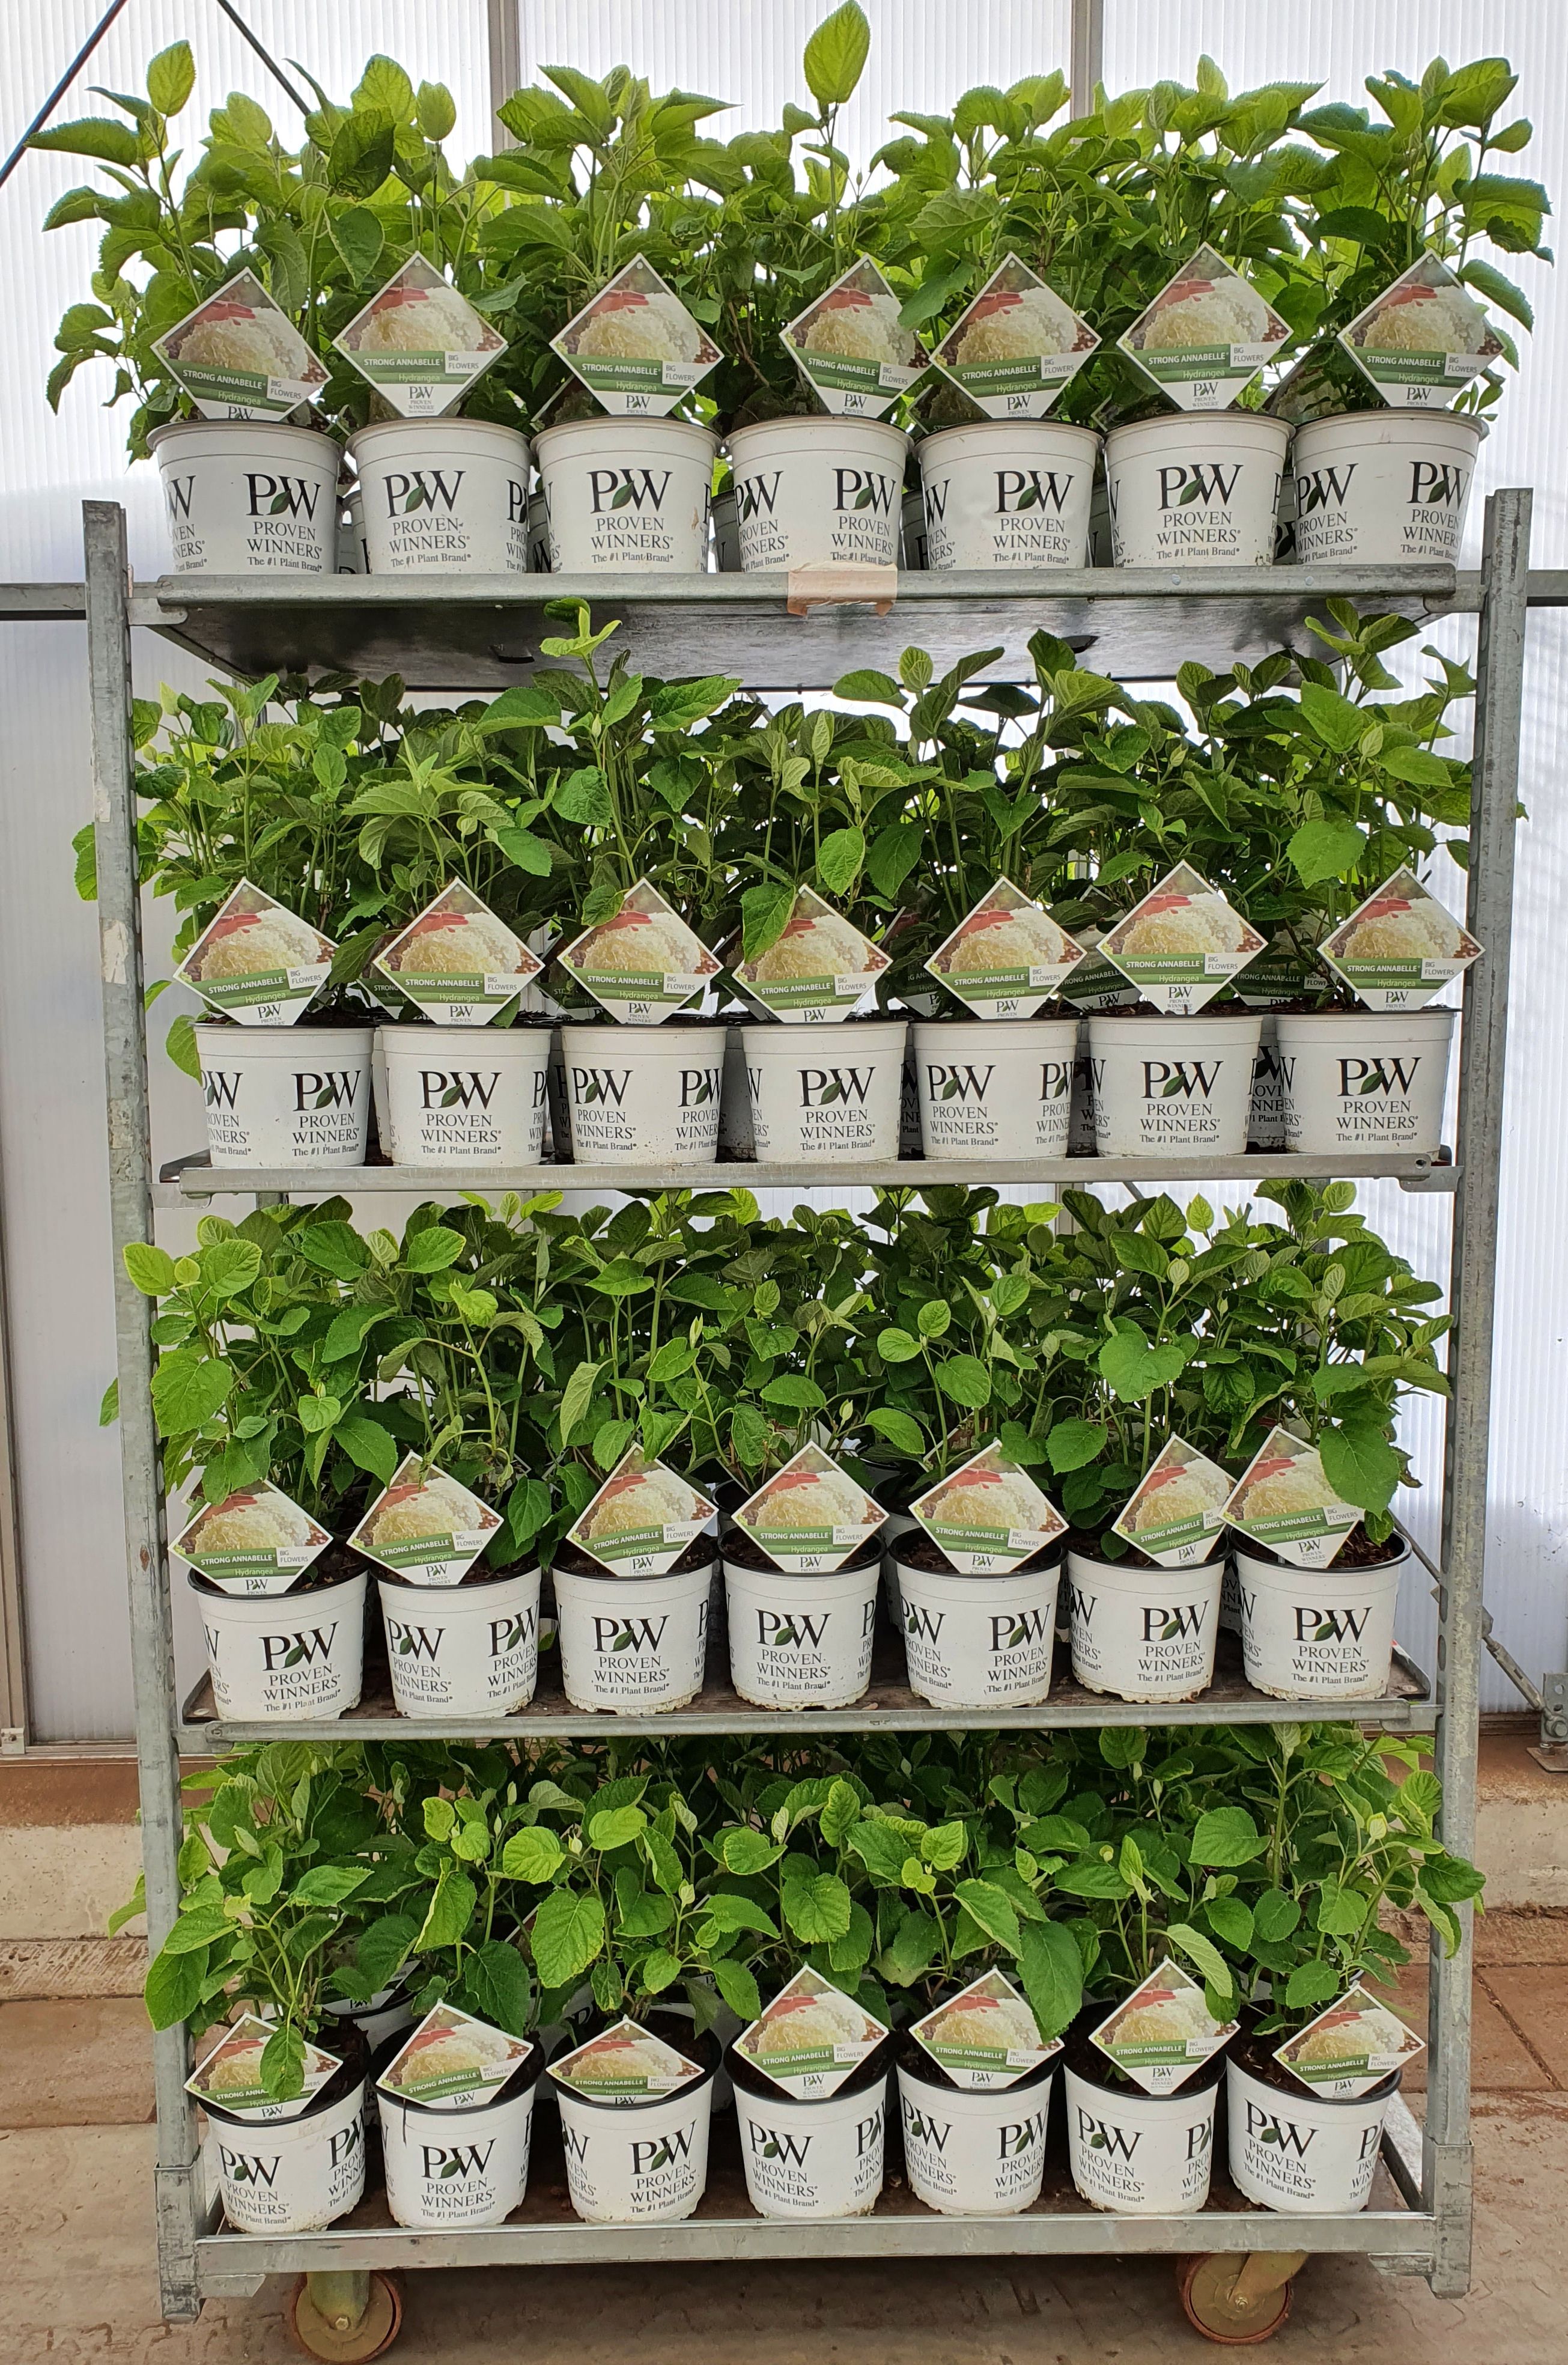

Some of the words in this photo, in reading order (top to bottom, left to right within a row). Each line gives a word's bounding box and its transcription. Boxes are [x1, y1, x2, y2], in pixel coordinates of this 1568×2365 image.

[582, 364, 613, 372] STRONG
[1149, 356, 1179, 365] STRONG
[1183, 370, 1225, 380] Hydrangea
[616, 382, 657, 392] Hydrangea
[243, 473, 321, 522] PW
[383, 470, 466, 519] PW
[586, 469, 673, 514] PW
[831, 469, 896, 517] PW
[994, 471, 1075, 514] PW
[1156, 464, 1244, 511] PW
[393, 518, 459, 536] PROVEN
[597, 516, 664, 531] PROVEN
[838, 516, 891, 537] PROVEN
[1000, 518, 1065, 532] PROVEN
[1163, 512, 1232, 528] PROVEN
[253, 522, 316, 541] PROVEN
[592, 555, 607, 563] The
[1156, 550, 1171, 559] The
[571, 1068, 633, 1107] PW
[797, 1067, 876, 1107] PW
[926, 1065, 996, 1102] PW
[1140, 1061, 1224, 1100] PW
[1336, 1057, 1422, 1096] PW
[291, 1070, 361, 1112] PW
[418, 1071, 502, 1110] PW
[577, 1110, 626, 1124] PROVEN
[806, 1109, 868, 1124] PROVEN
[932, 1106, 988, 1118] PROVEN
[1147, 1103, 1212, 1116] PROVEN
[1343, 1100, 1411, 1113] PROVEN
[299, 1113, 355, 1128] PROVEN
[427, 1114, 492, 1127] PROVEN
[1251, 1521, 1280, 1532] STRONG
[1329, 1512, 1358, 1521] FLOWERS
[1286, 1529, 1324, 1540] Hydrangea
[755, 1609, 831, 1649] PW
[988, 1604, 1051, 1652] PW
[1140, 1599, 1209, 1643] PW
[1292, 1606, 1373, 1644] PW
[386, 1615, 446, 1662] PW
[591, 1615, 670, 1653] PW
[259, 1621, 339, 1672] PW
[761, 1649, 821, 1664] PROVEN
[994, 1645, 1044, 1667] PROVEN
[1145, 1640, 1200, 1658] PROVEN
[1298, 1647, 1363, 1659] PROVEN
[394, 1657, 441, 1678] PROVEN
[599, 1656, 661, 1669] PROVEN
[269, 1663, 333, 1686] PROVEN
[1291, 1673, 1307, 1681] The
[1076, 2105, 1143, 2163] PW
[1244, 2099, 1319, 2158] PW
[628, 2119, 697, 2176] PW
[747, 2117, 813, 2168] PW
[217, 2142, 282, 2187] PW
[419, 2138, 497, 2180] PW
[1081, 2144, 1135, 2178] PROVEN
[1249, 2139, 1307, 2173] PROVEN
[636, 2163, 691, 2188] PROVEN
[754, 2157, 808, 2184] PROVEN
[226, 2181, 278, 2202] PROVEN
[427, 2179, 488, 2194] PROVEN
[421, 2208, 434, 2217] The
